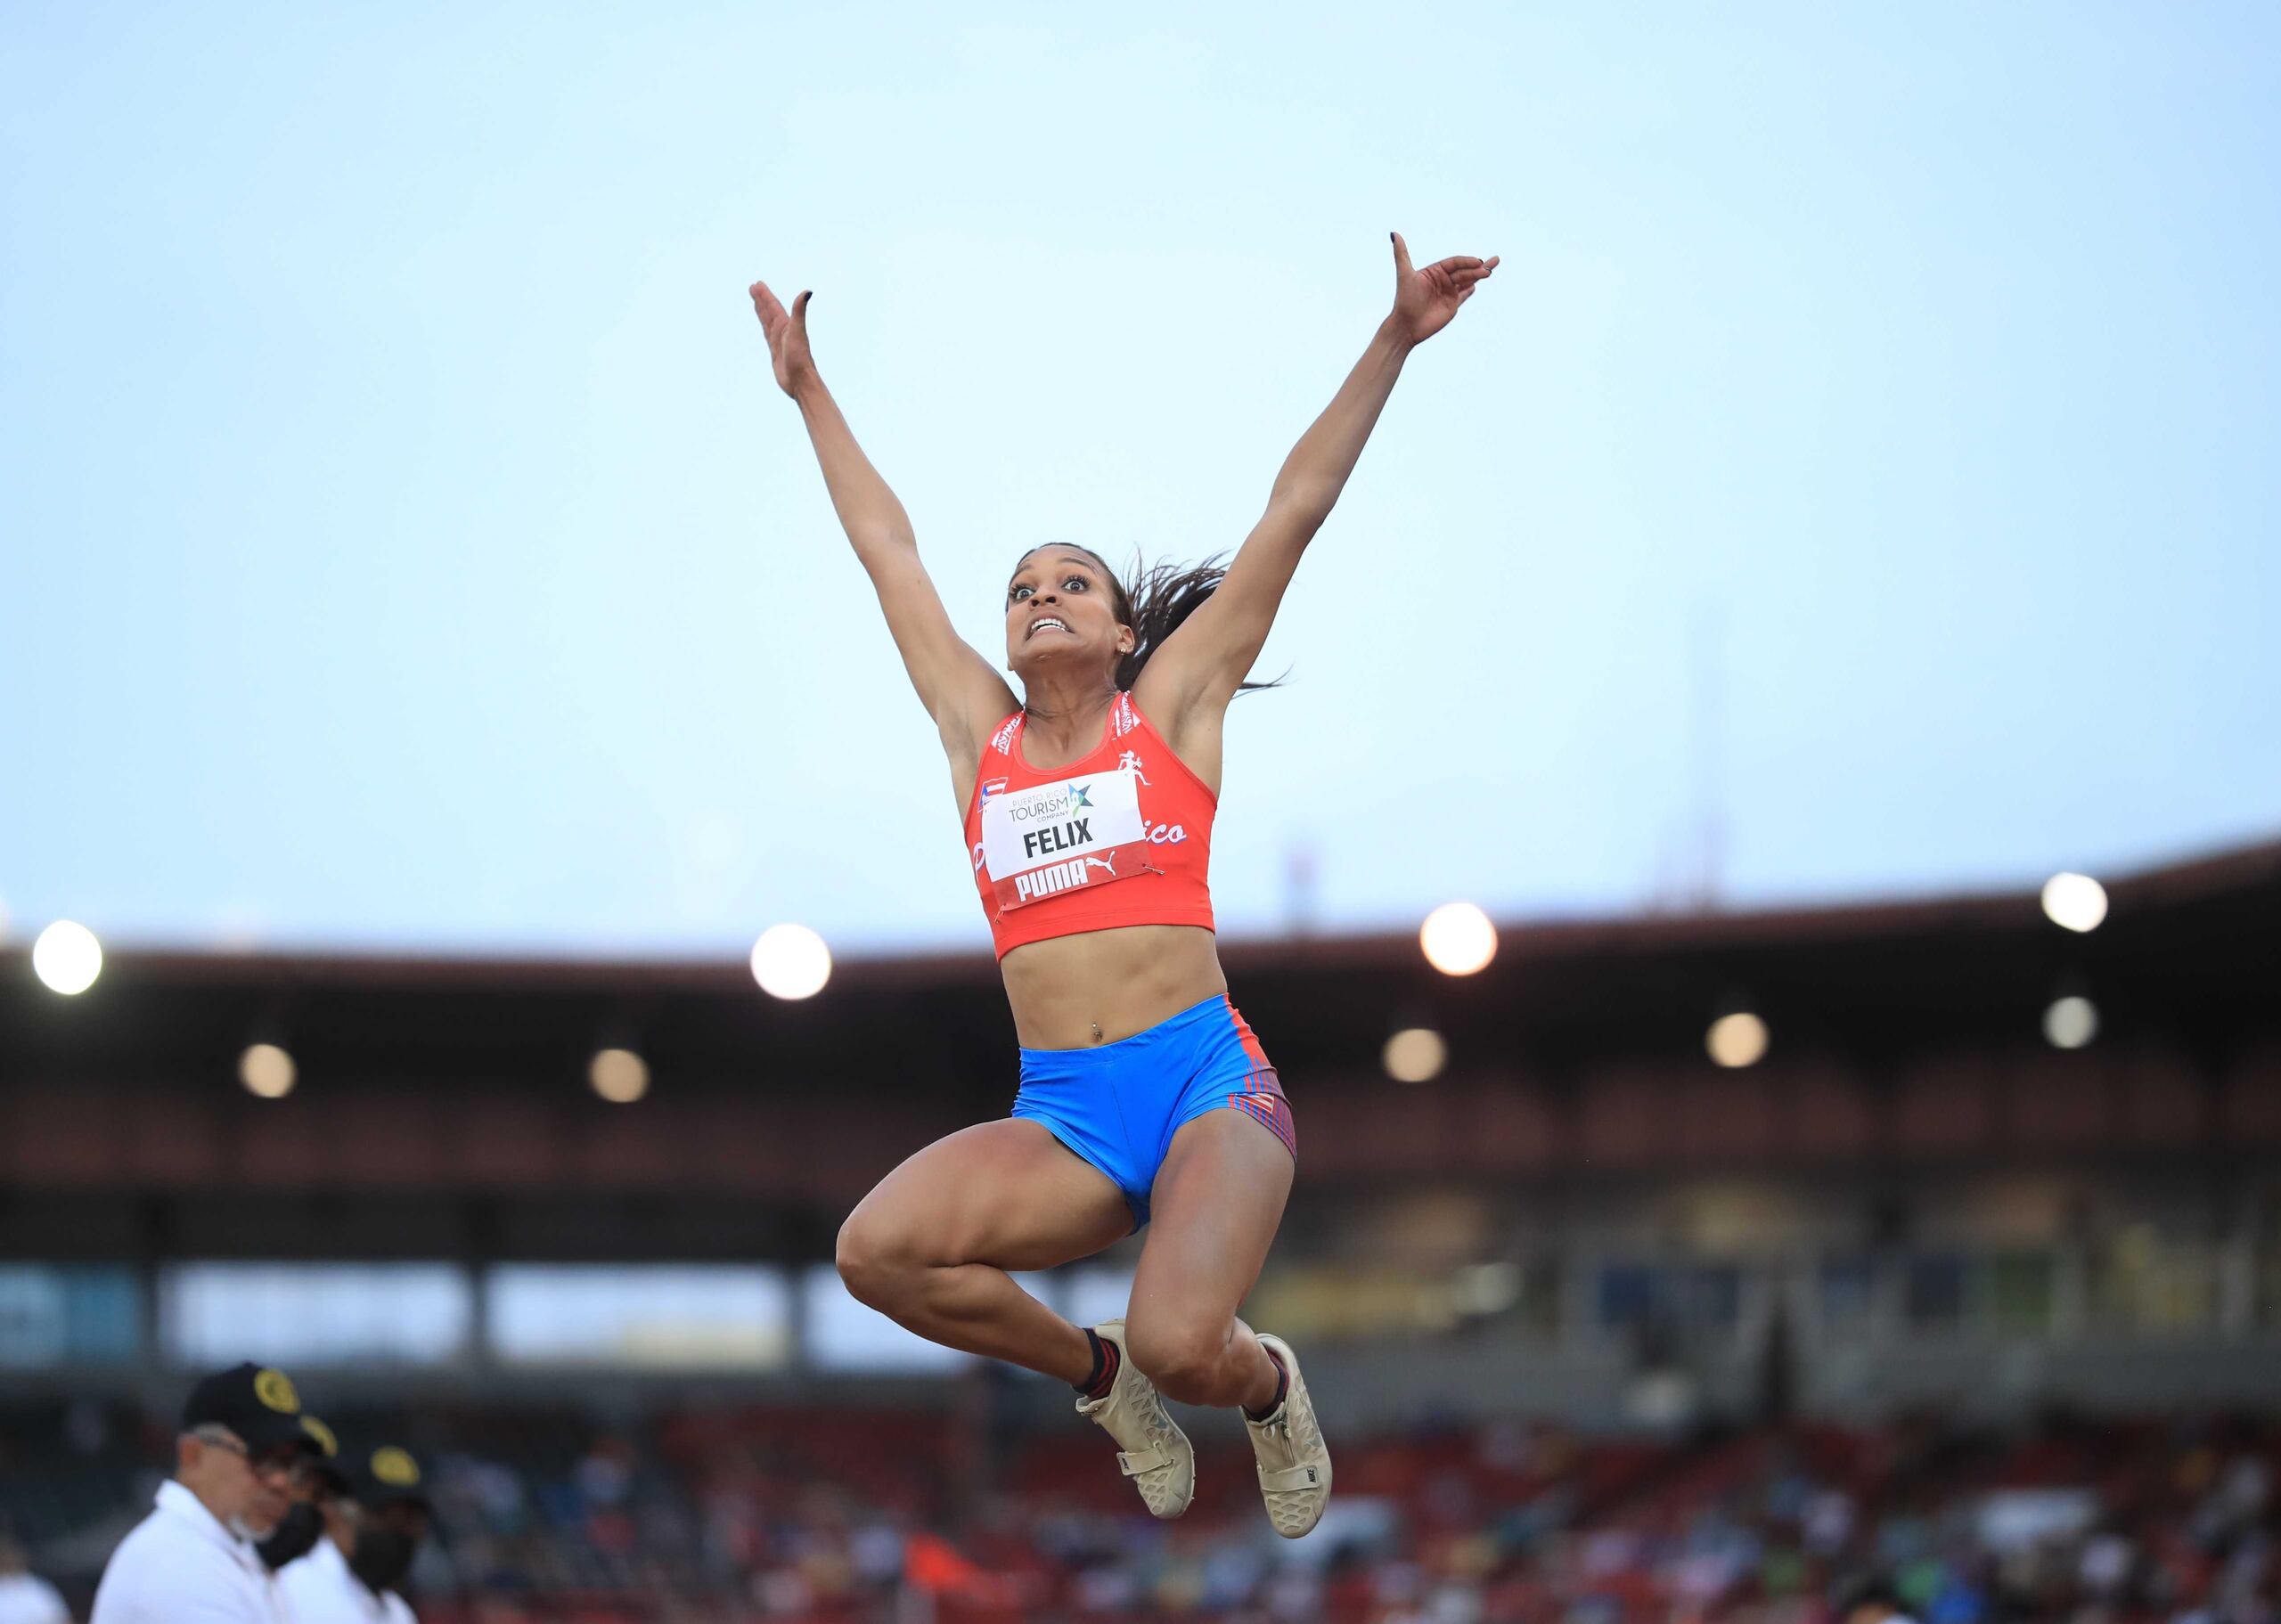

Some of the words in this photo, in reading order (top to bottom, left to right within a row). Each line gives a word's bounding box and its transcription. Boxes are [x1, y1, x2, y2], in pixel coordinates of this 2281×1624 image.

[1009, 796, 1068, 822] TOURISM
[1012, 795, 1042, 807] PUERTO
[1046, 788, 1067, 799] RICO
[1036, 809, 1068, 823] COMPANY
[1024, 818, 1093, 858] FELIX
[1142, 820, 1188, 845] ico
[1015, 858, 1088, 902] PUMA
